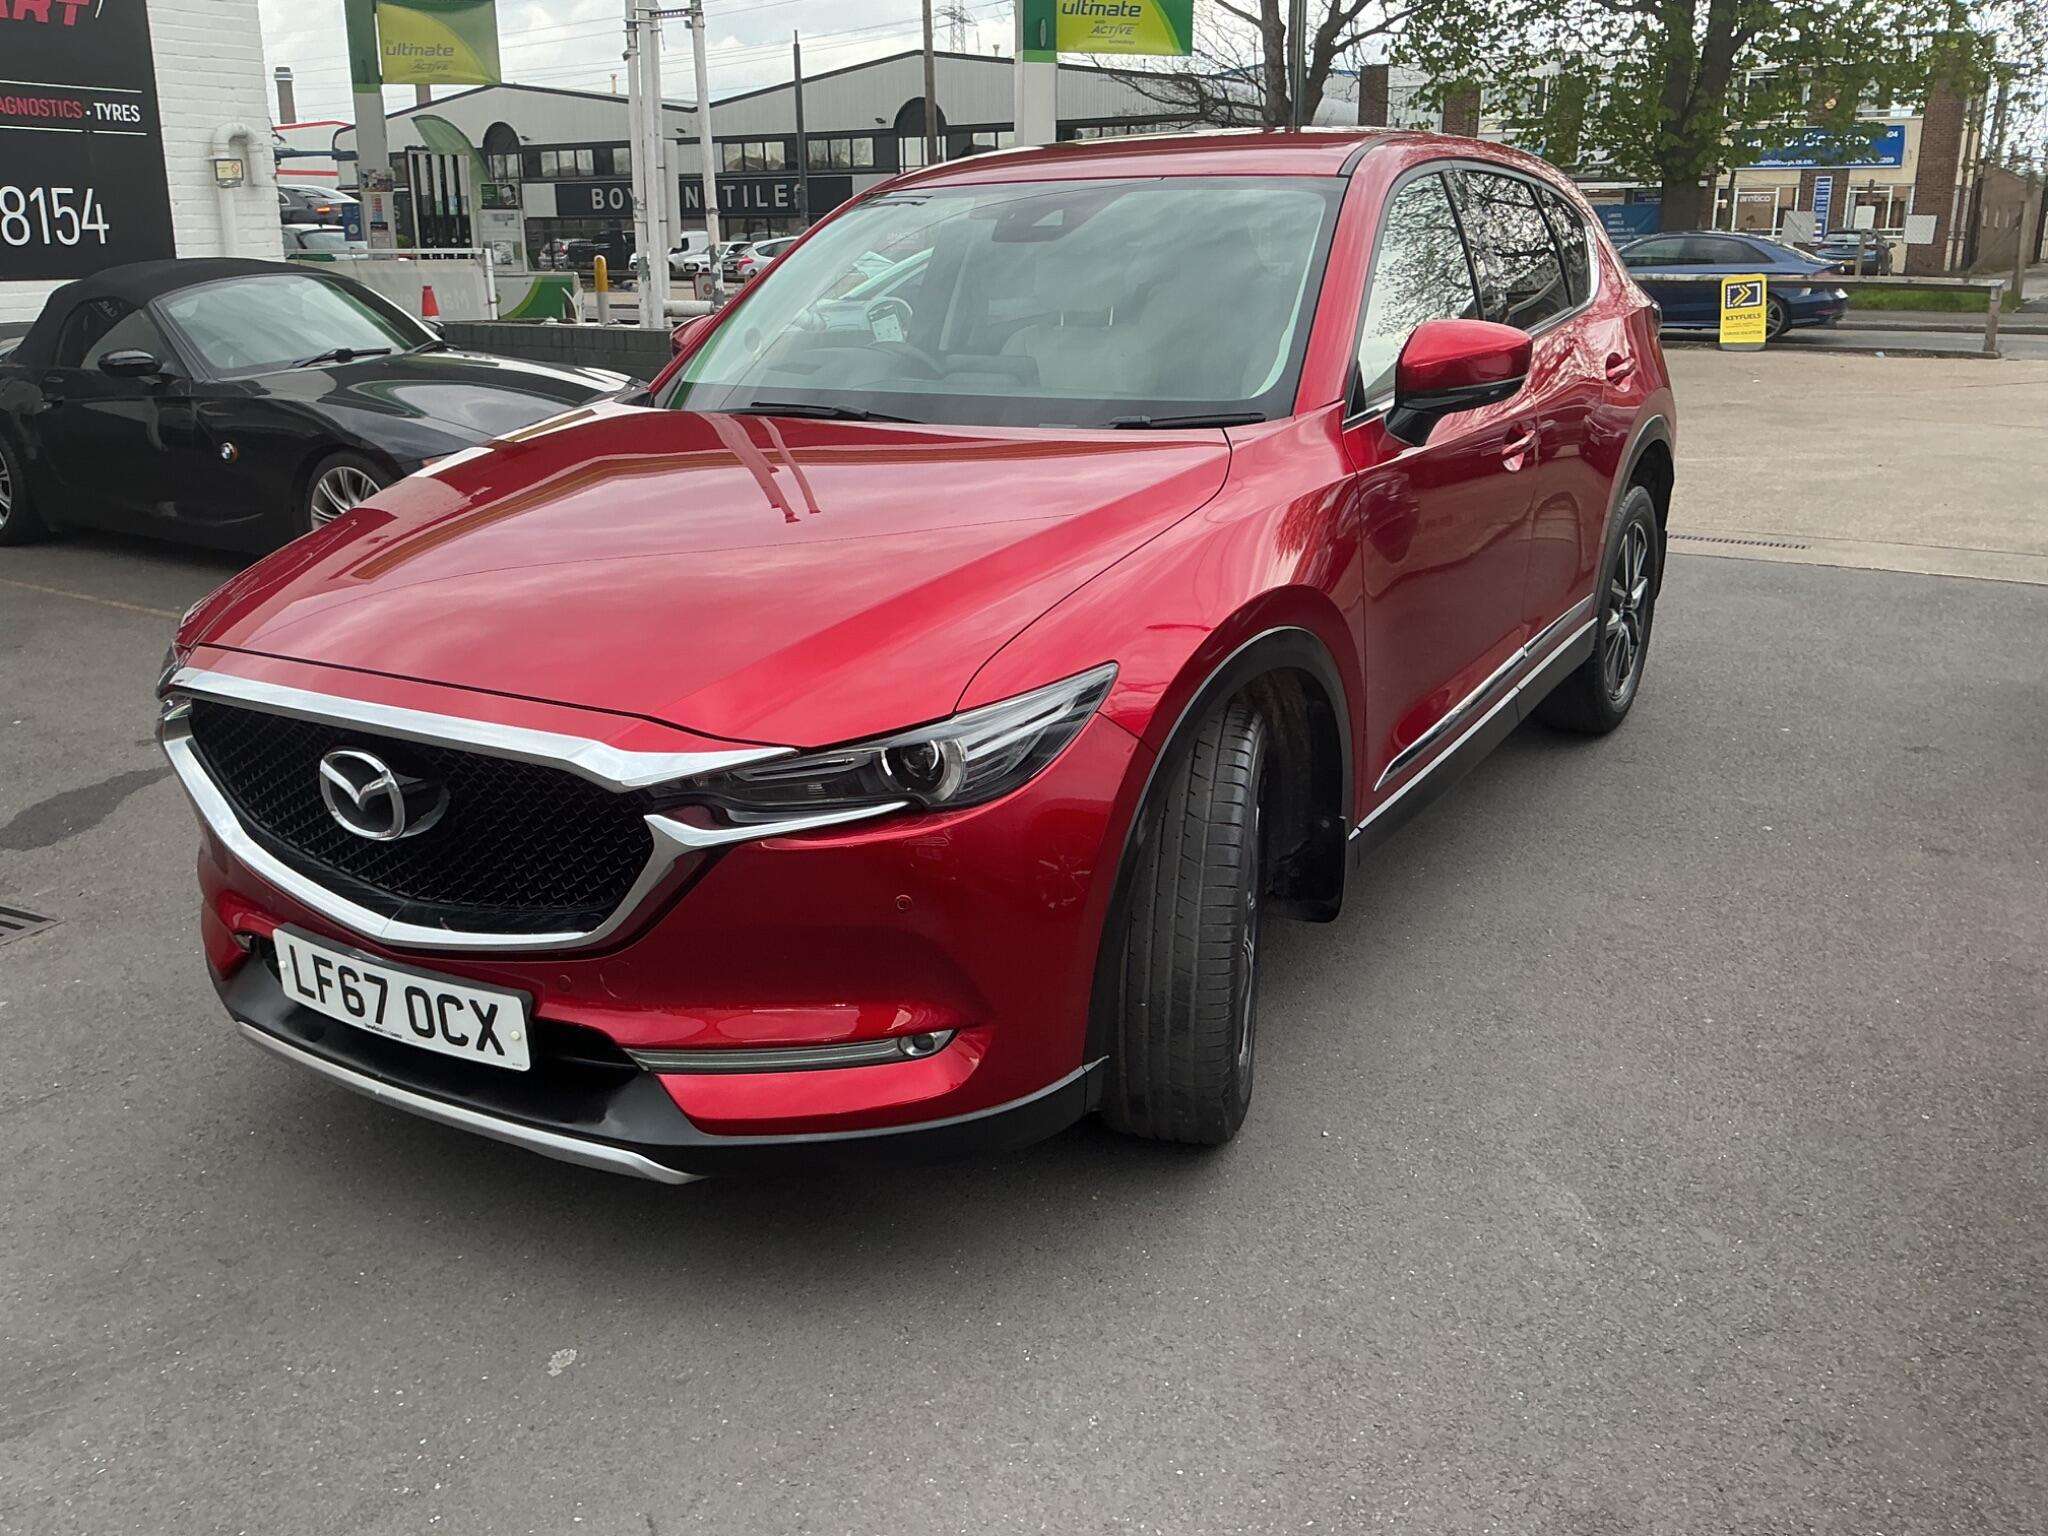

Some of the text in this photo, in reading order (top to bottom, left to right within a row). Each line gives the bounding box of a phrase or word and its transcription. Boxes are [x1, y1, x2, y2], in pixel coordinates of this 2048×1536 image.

[0, 0, 90, 26] RT
[1062, 0, 1141, 17] ultimate
[1091, 26, 1134, 36] ACTIVE
[385, 42, 455, 57] ultimate
[93, 102, 141, 122] TYRES
[0, 185, 110, 246] 8154
[1725, 313, 1762, 321] KEYFUELS
[289, 945, 506, 1057] LF67 OCX
